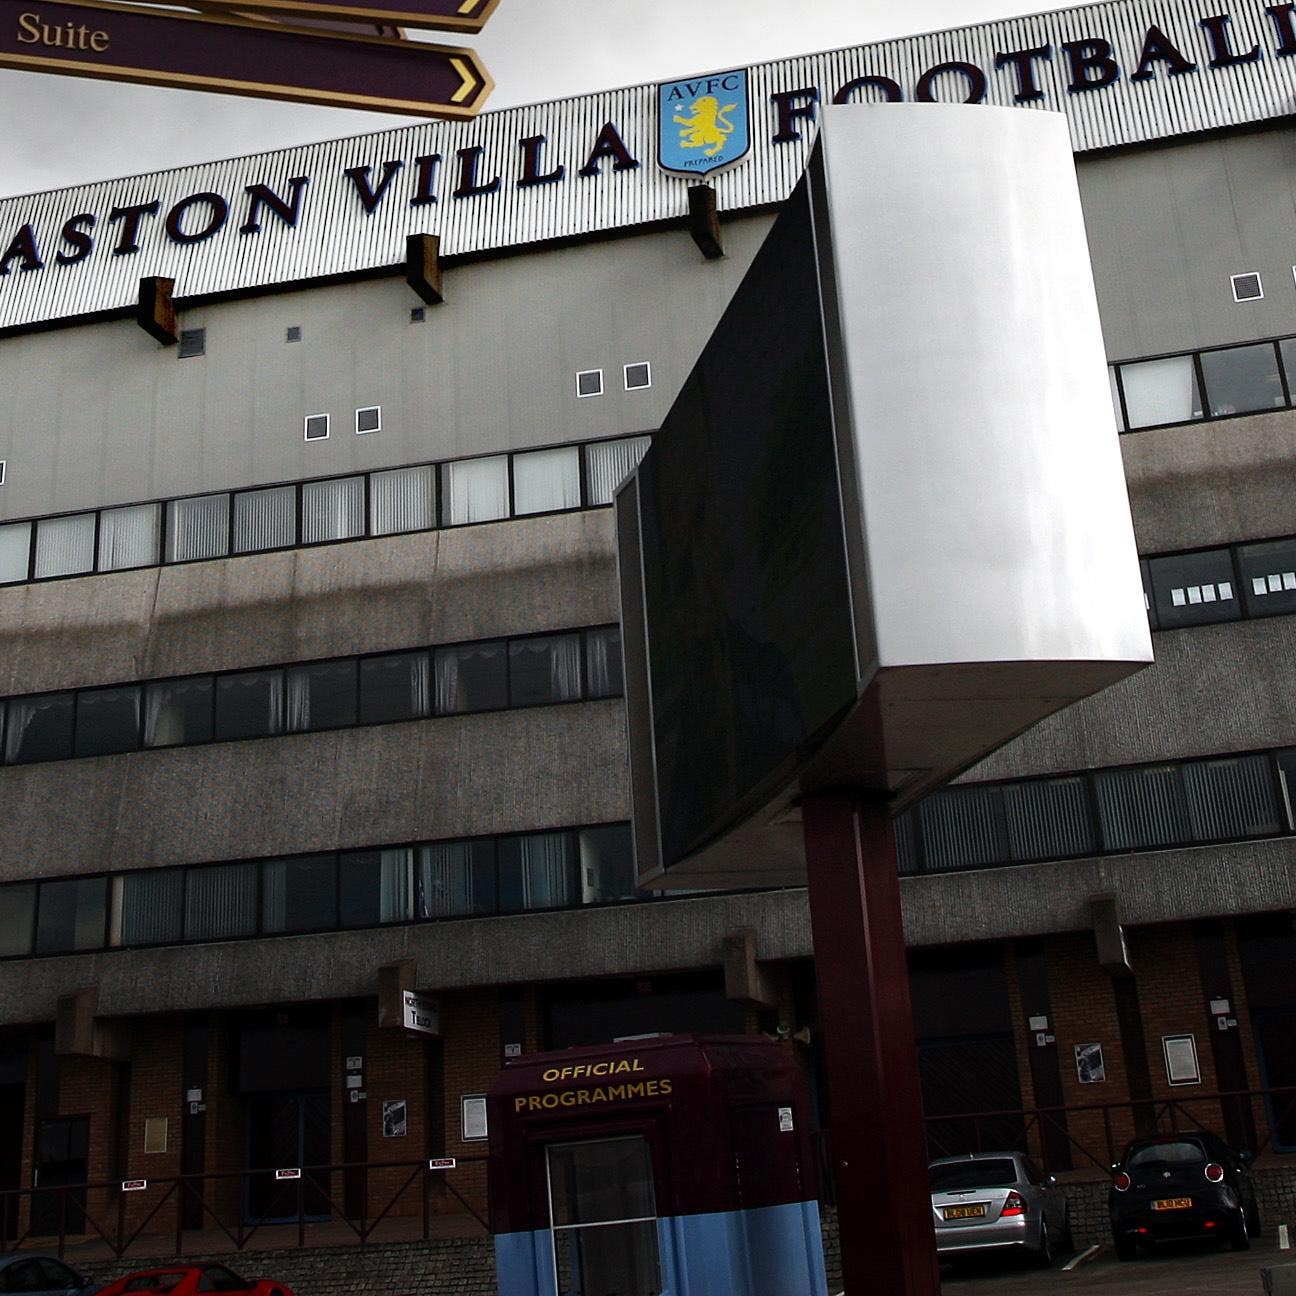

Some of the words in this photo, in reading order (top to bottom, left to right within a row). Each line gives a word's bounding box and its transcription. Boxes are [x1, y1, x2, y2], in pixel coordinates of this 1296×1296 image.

[16, 12, 110, 53] Suite
[667, 75, 739, 102] AVFC
[344, 120, 640, 216] VILLA
[684, 155, 724, 167] PREPARED
[542, 1058, 645, 1082] OFFICIAL
[514, 1078, 673, 1113] PROGRAMMES
